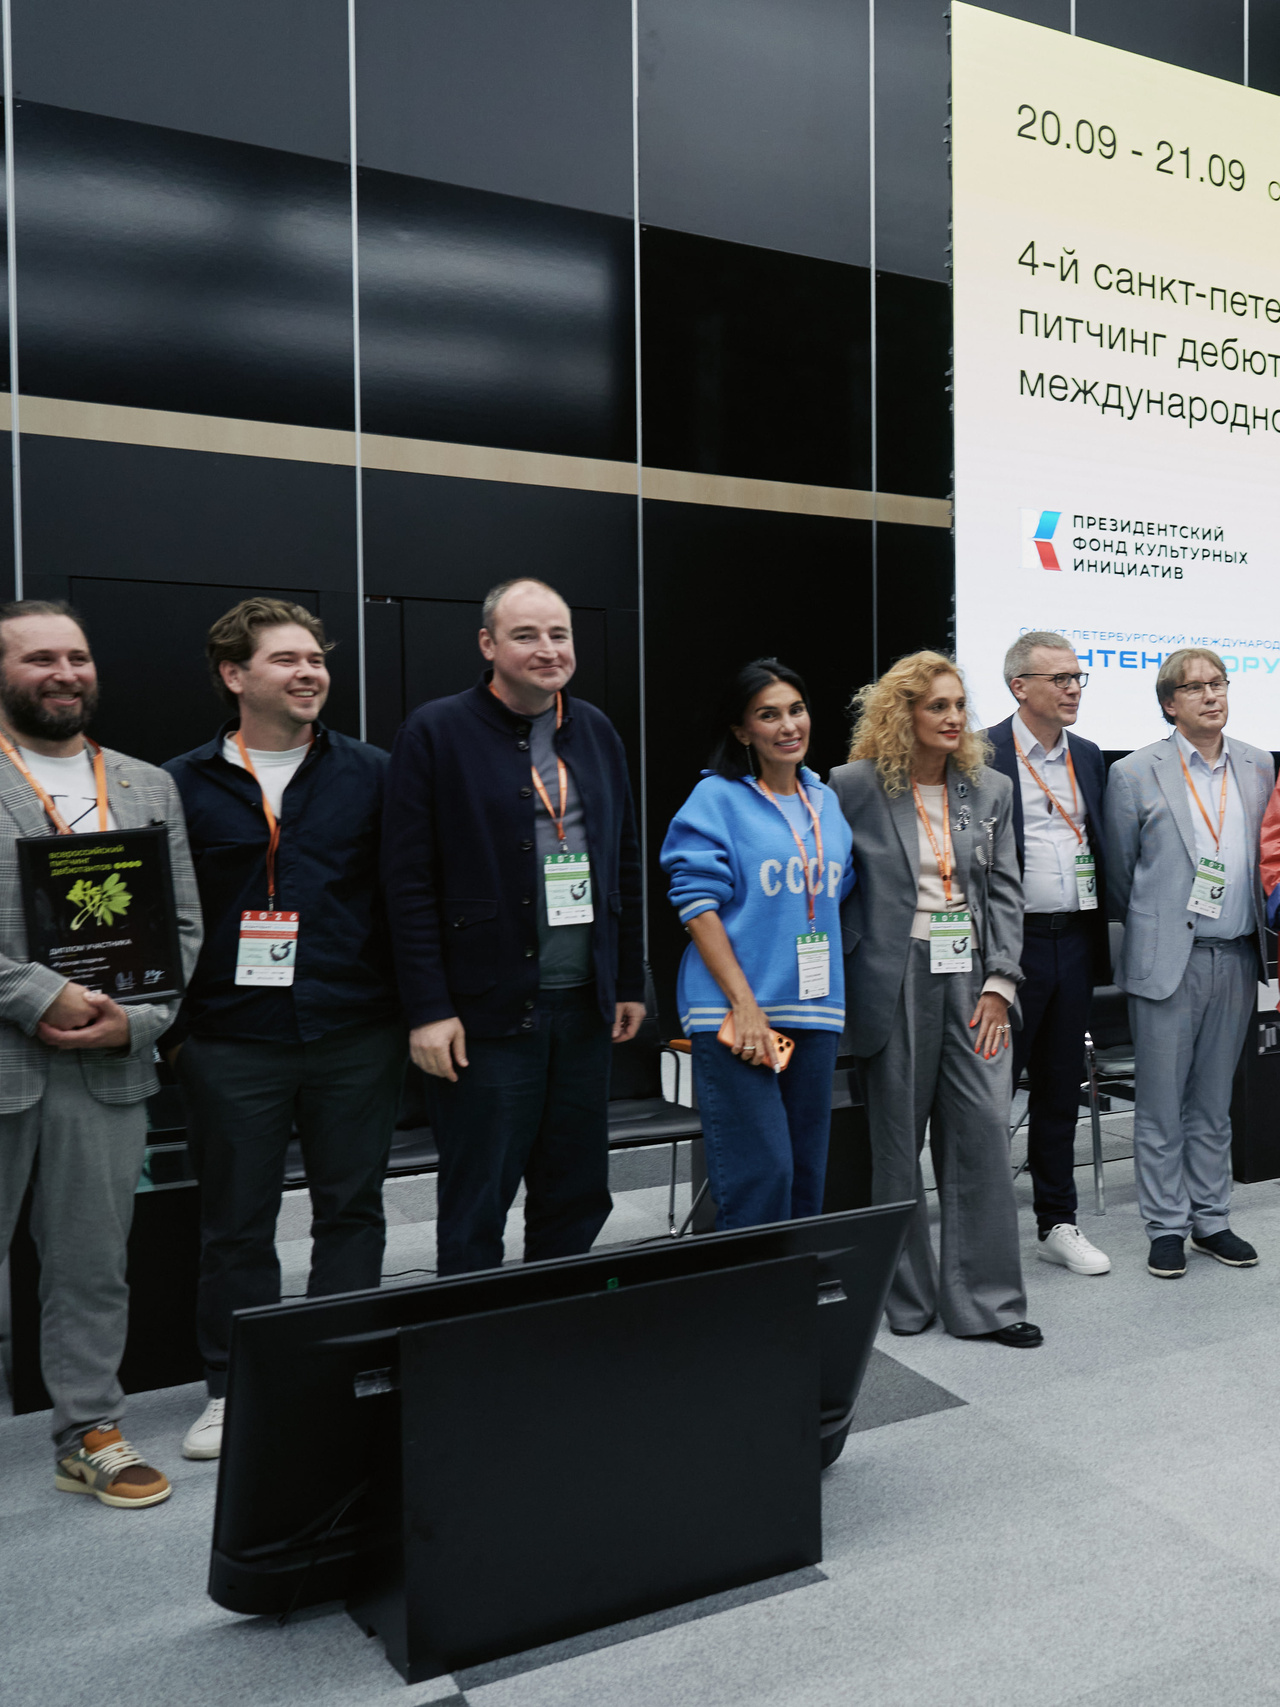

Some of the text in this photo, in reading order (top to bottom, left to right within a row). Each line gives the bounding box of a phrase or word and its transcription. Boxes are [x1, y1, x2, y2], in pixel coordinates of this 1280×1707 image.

[1016, 104, 1117, 160] 20.09
[1156, 140, 1246, 192] 21.09
[1018, 240, 1079, 285] 4-й
[1018, 308, 1167, 358] питчинг
[1073, 514, 1225, 542] ПРЕЗИДЕНТСКИЙ
[1072, 536, 1248, 565] ФОНД КУЛЬТУРНЫХ
[1073, 558, 1184, 580] ИНИЦИАТИВ
[759, 856, 842, 898] СССР
[244, 911, 298, 921] 2026
